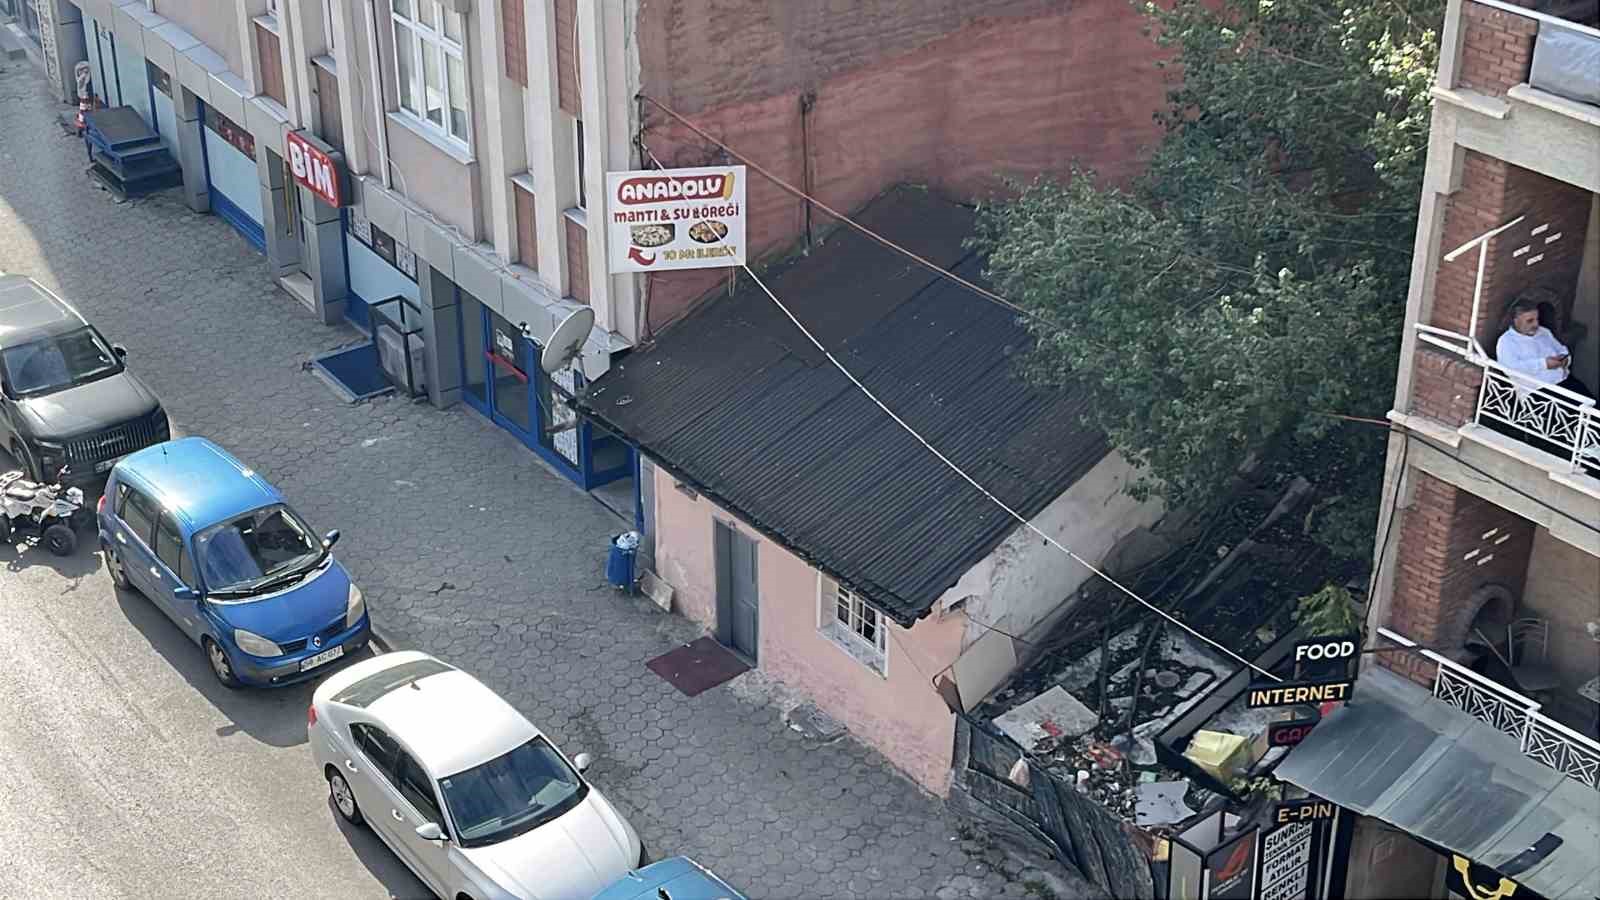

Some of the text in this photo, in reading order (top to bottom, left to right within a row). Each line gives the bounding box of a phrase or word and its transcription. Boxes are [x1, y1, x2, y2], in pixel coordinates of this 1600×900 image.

[289, 141, 335, 200] BİM
[621, 178, 722, 201] ANADOLU
[660, 208, 671, 221] &
[673, 208, 690, 220] SU
[1296, 641, 1355, 662] FOOD
[1250, 683, 1350, 706] INTERNET
[1266, 841, 1308, 874] FORMAT
